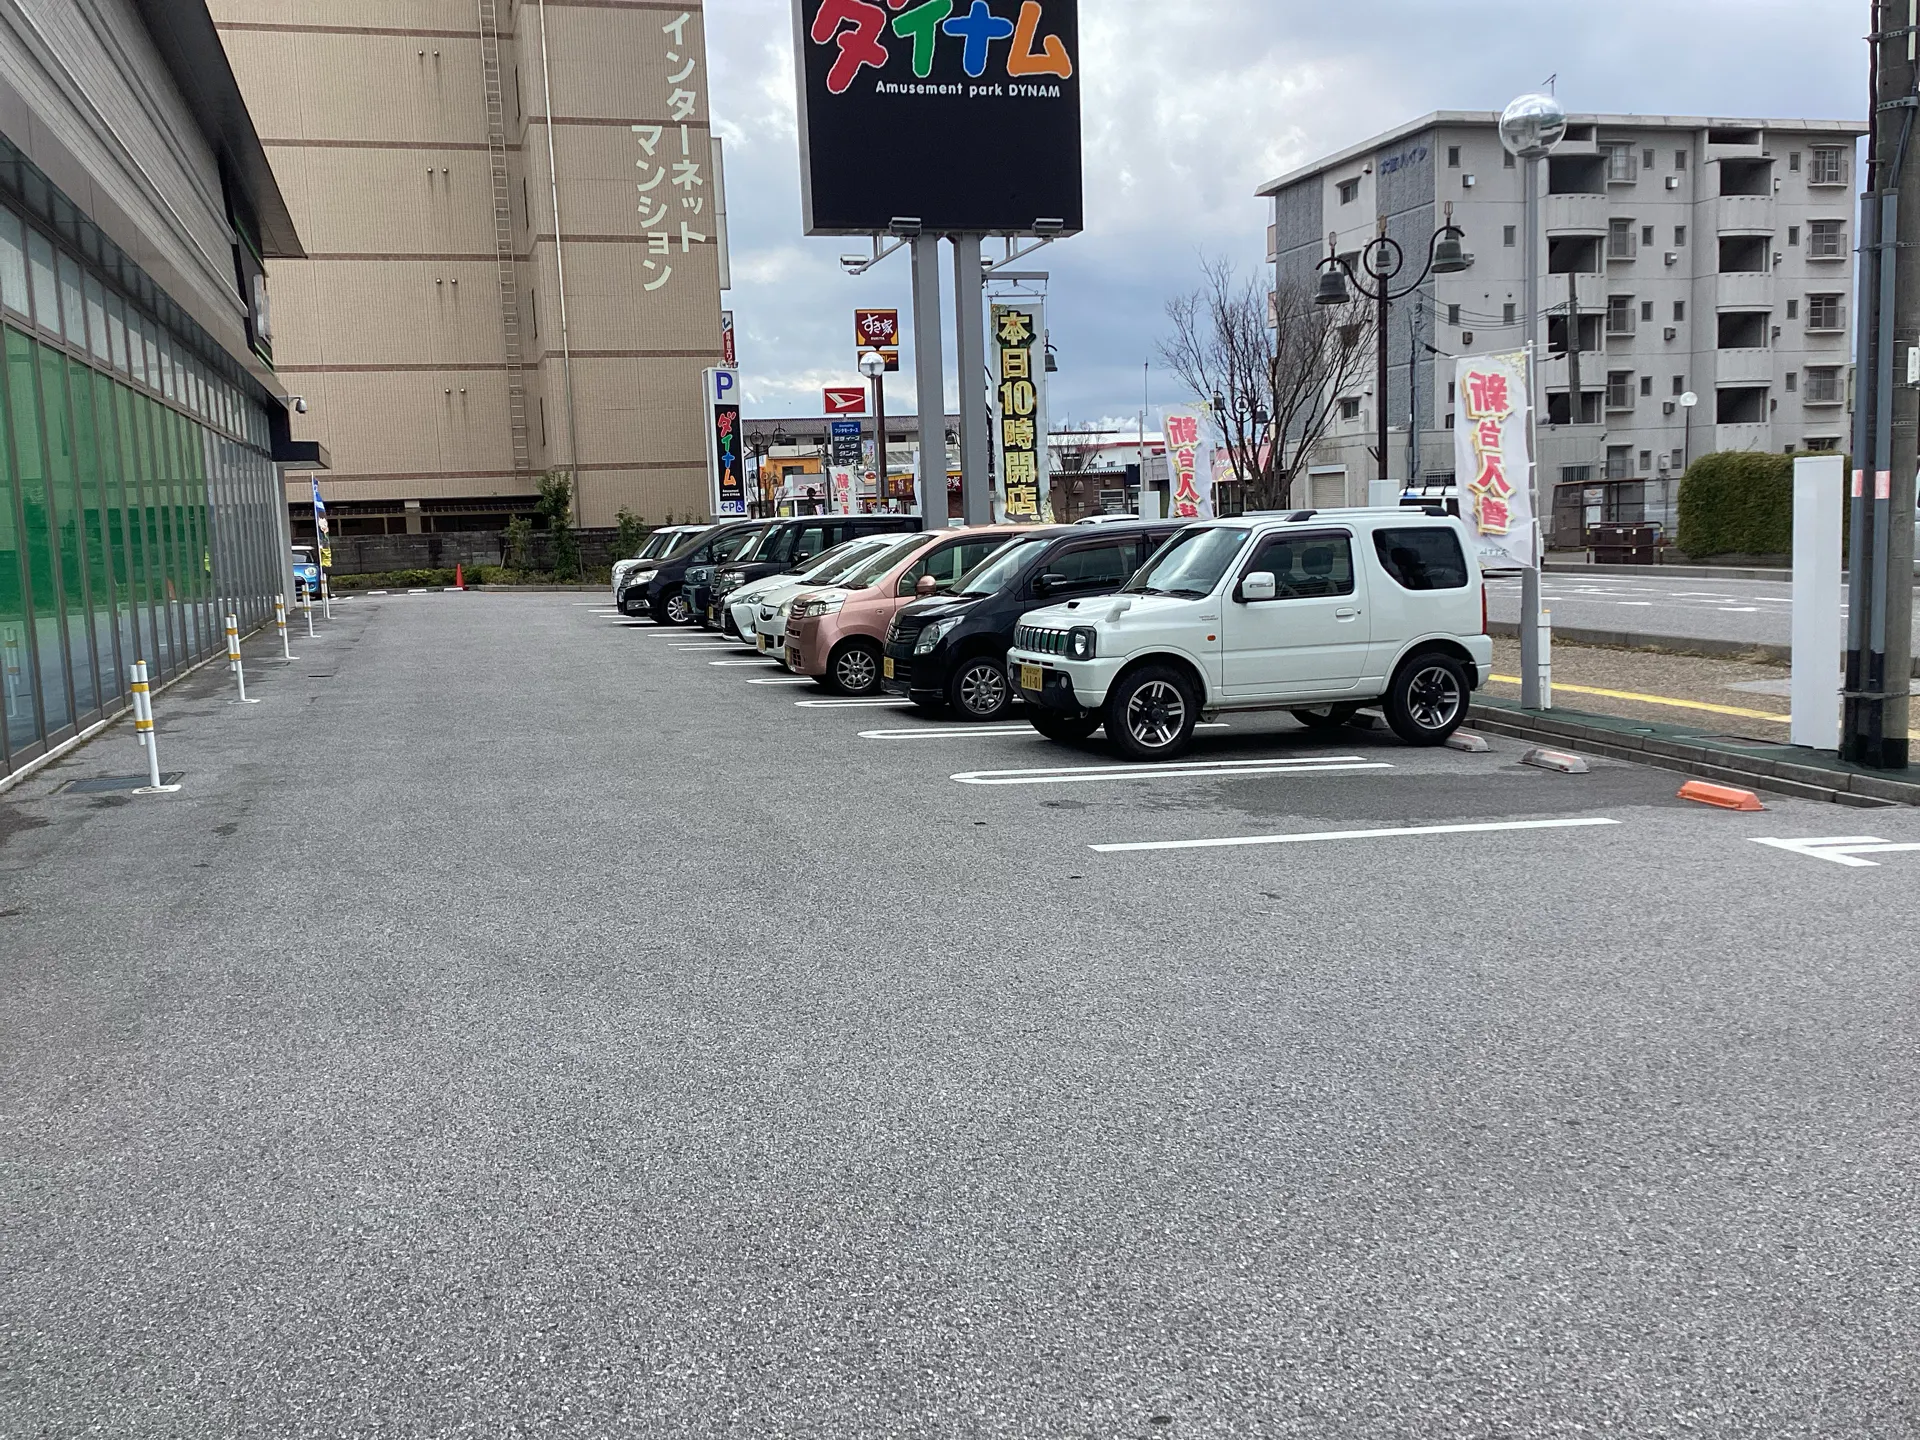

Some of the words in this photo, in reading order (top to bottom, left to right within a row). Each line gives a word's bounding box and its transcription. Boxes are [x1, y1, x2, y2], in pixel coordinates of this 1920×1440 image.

[811, 0, 1073, 94] ダイナム
[875, 80, 963, 95] Amusement
[969, 83, 1003, 98] park
[1009, 83, 1061, 98] DYNAM
[662, 12, 707, 254] インターネット
[631, 124, 672, 292] マンション
[861, 313, 894, 337] すき家
[715, 371, 734, 400] P
[998, 310, 1040, 516] 本日10時開店
[717, 411, 738, 486] ダイナム
[729, 503, 735, 512] P
